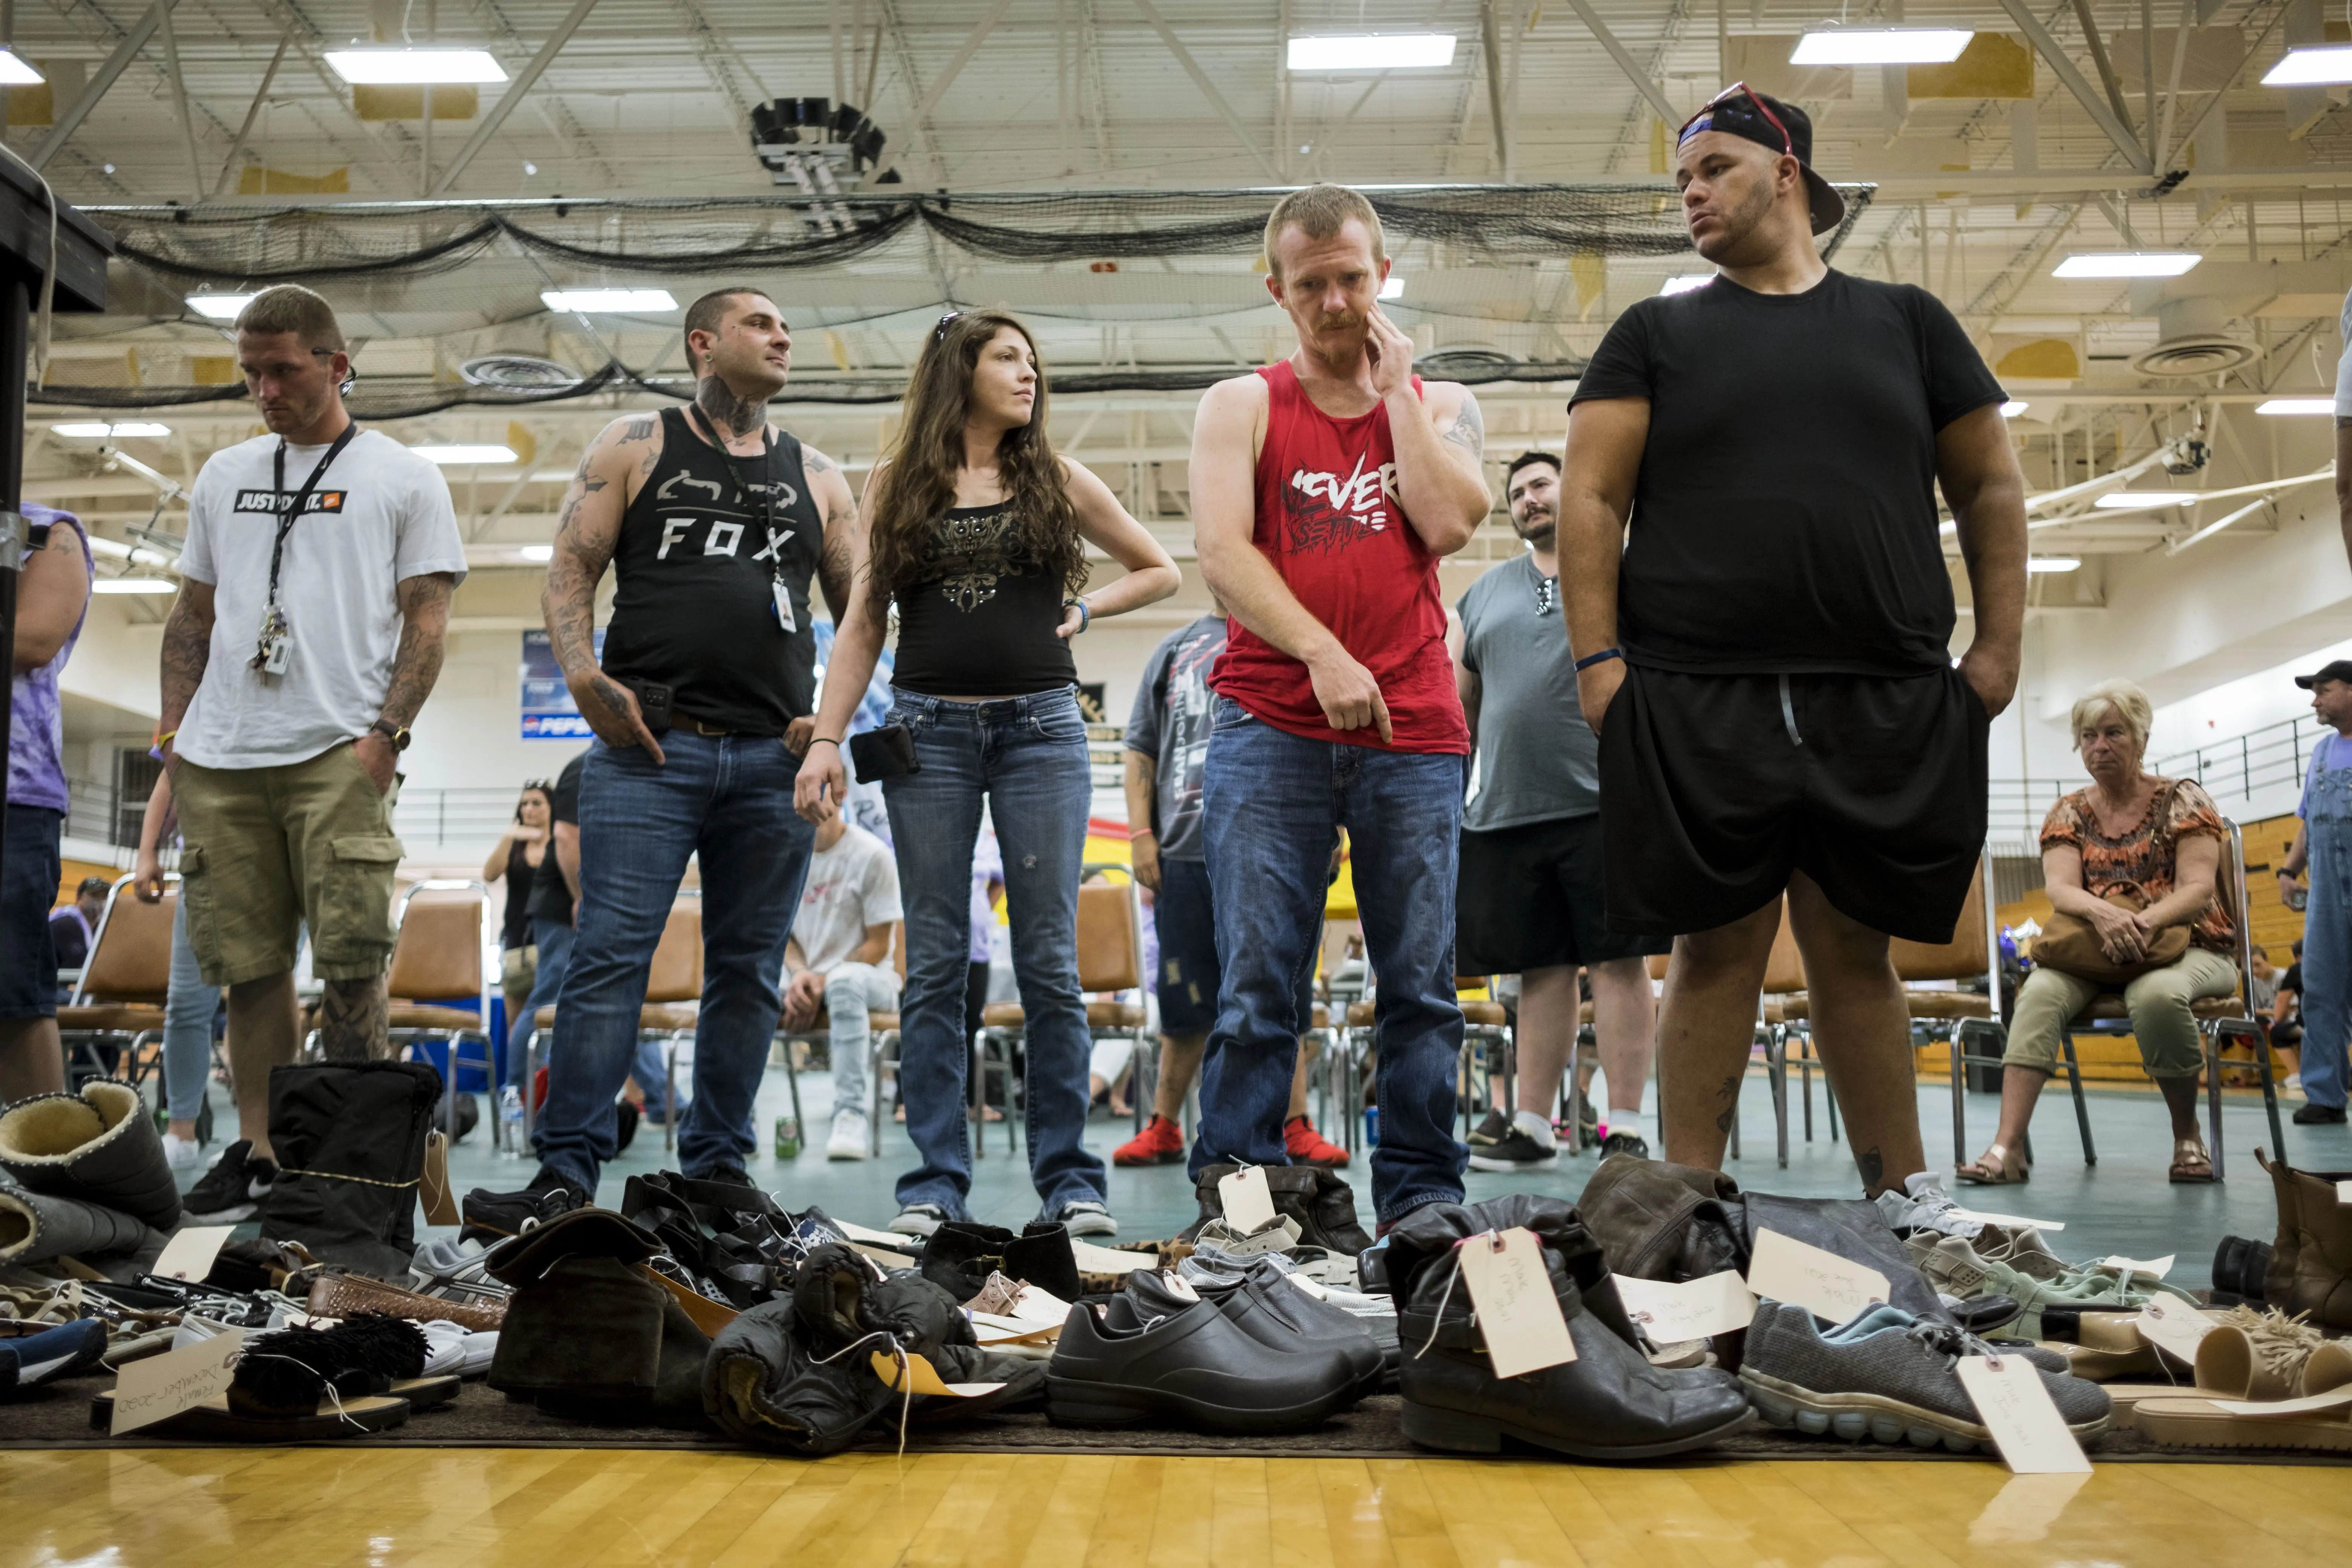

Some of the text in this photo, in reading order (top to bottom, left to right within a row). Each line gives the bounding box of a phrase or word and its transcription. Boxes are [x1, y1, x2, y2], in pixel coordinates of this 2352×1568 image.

[281, 494, 297, 511] D
[1282, 451, 1401, 515] NEVER
[657, 518, 795, 562] FOX
[118, 1364, 219, 1413] December 2020
[175, 1383, 214, 1409] Female
